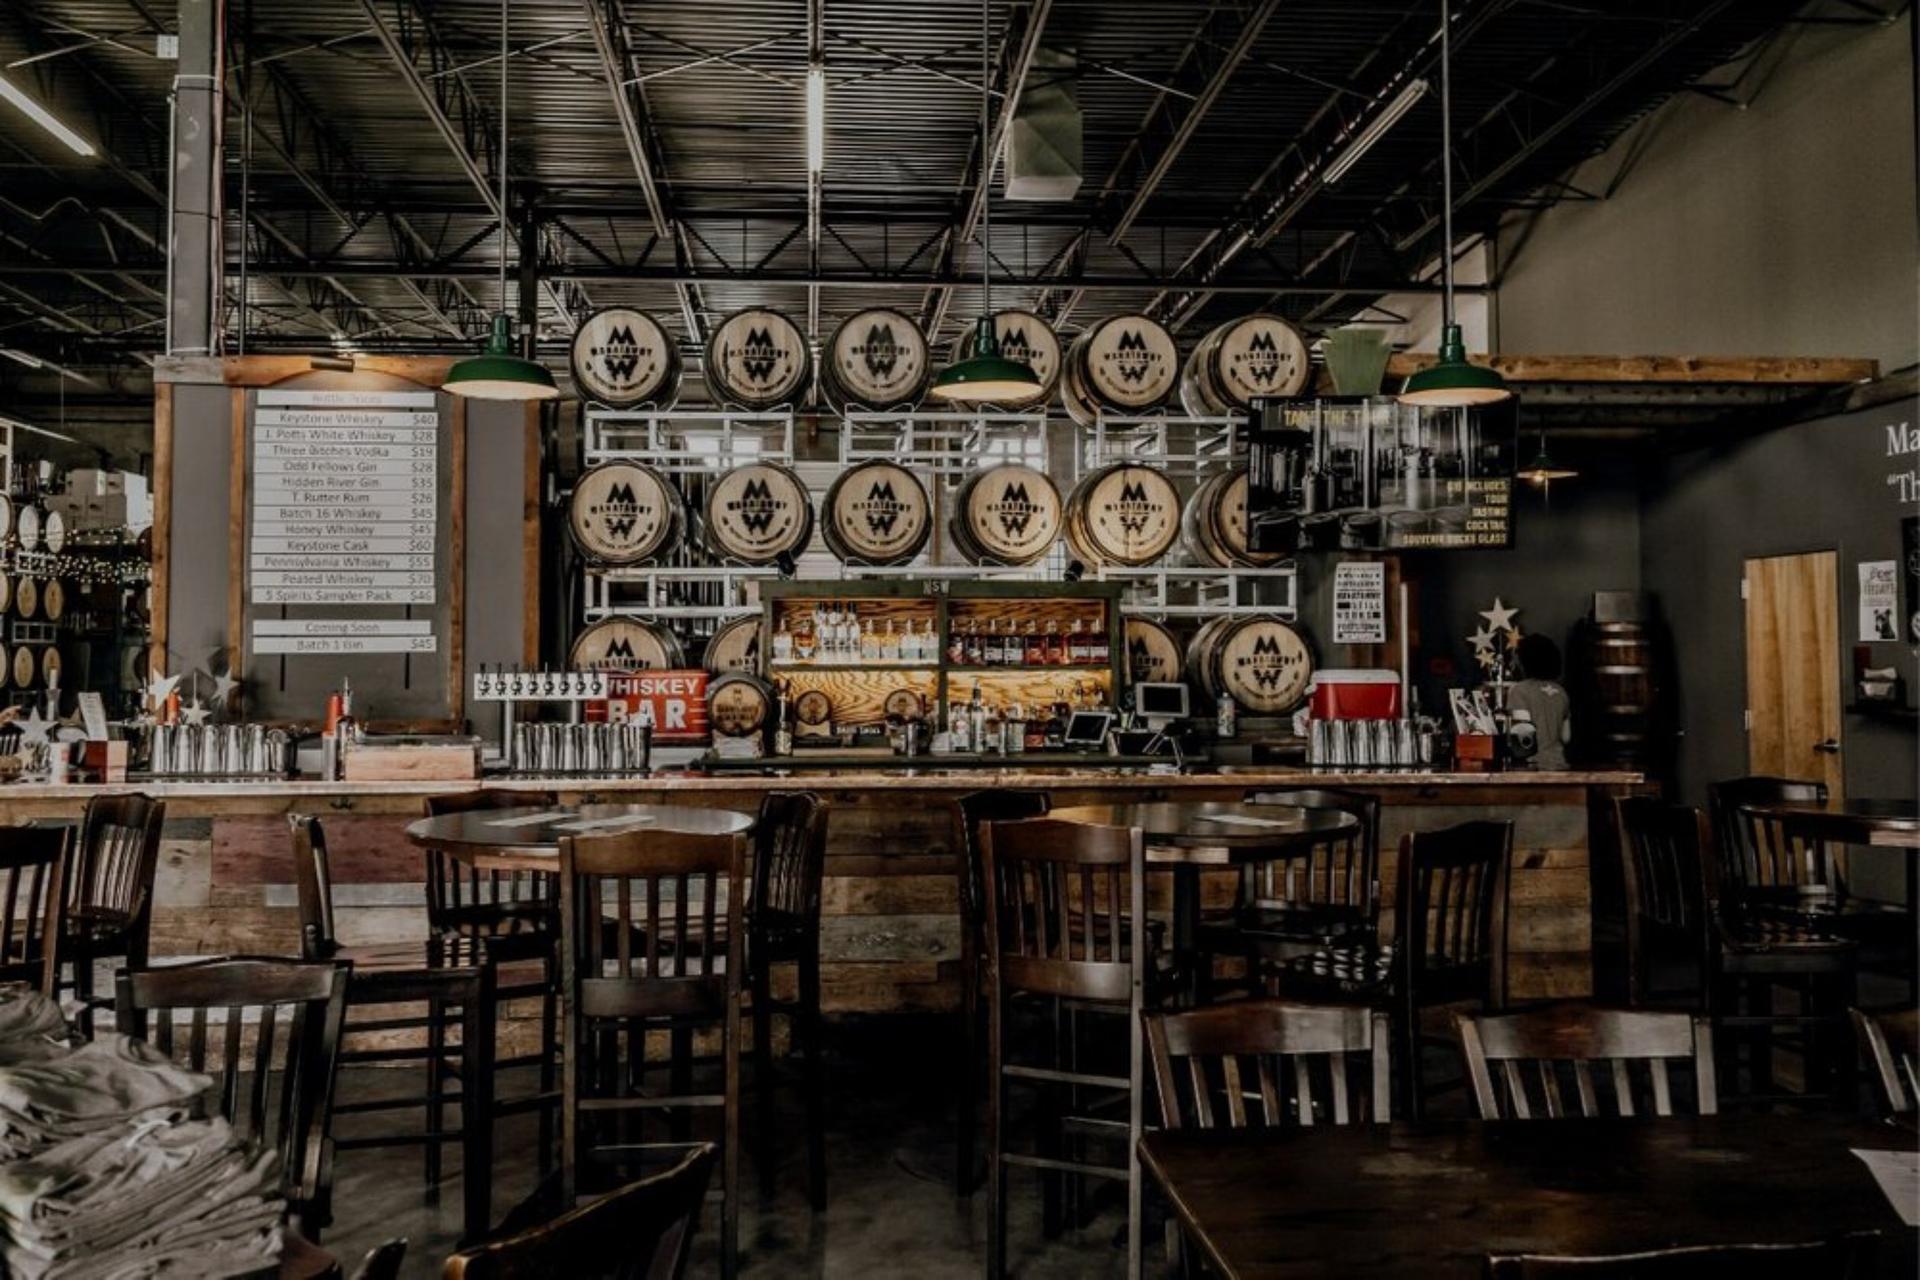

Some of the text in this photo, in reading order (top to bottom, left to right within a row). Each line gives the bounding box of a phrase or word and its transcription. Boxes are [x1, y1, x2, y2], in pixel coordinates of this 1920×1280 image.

[358, 461, 377, 472] Gin
[360, 477, 379, 487] Gin
[343, 493, 370, 503] Rum
[280, 508, 312, 518] Batch
[287, 540, 341, 551] Keystone
[343, 540, 369, 551] Cask
[366, 590, 392, 600] Pack
[608, 698, 687, 730] BAR
